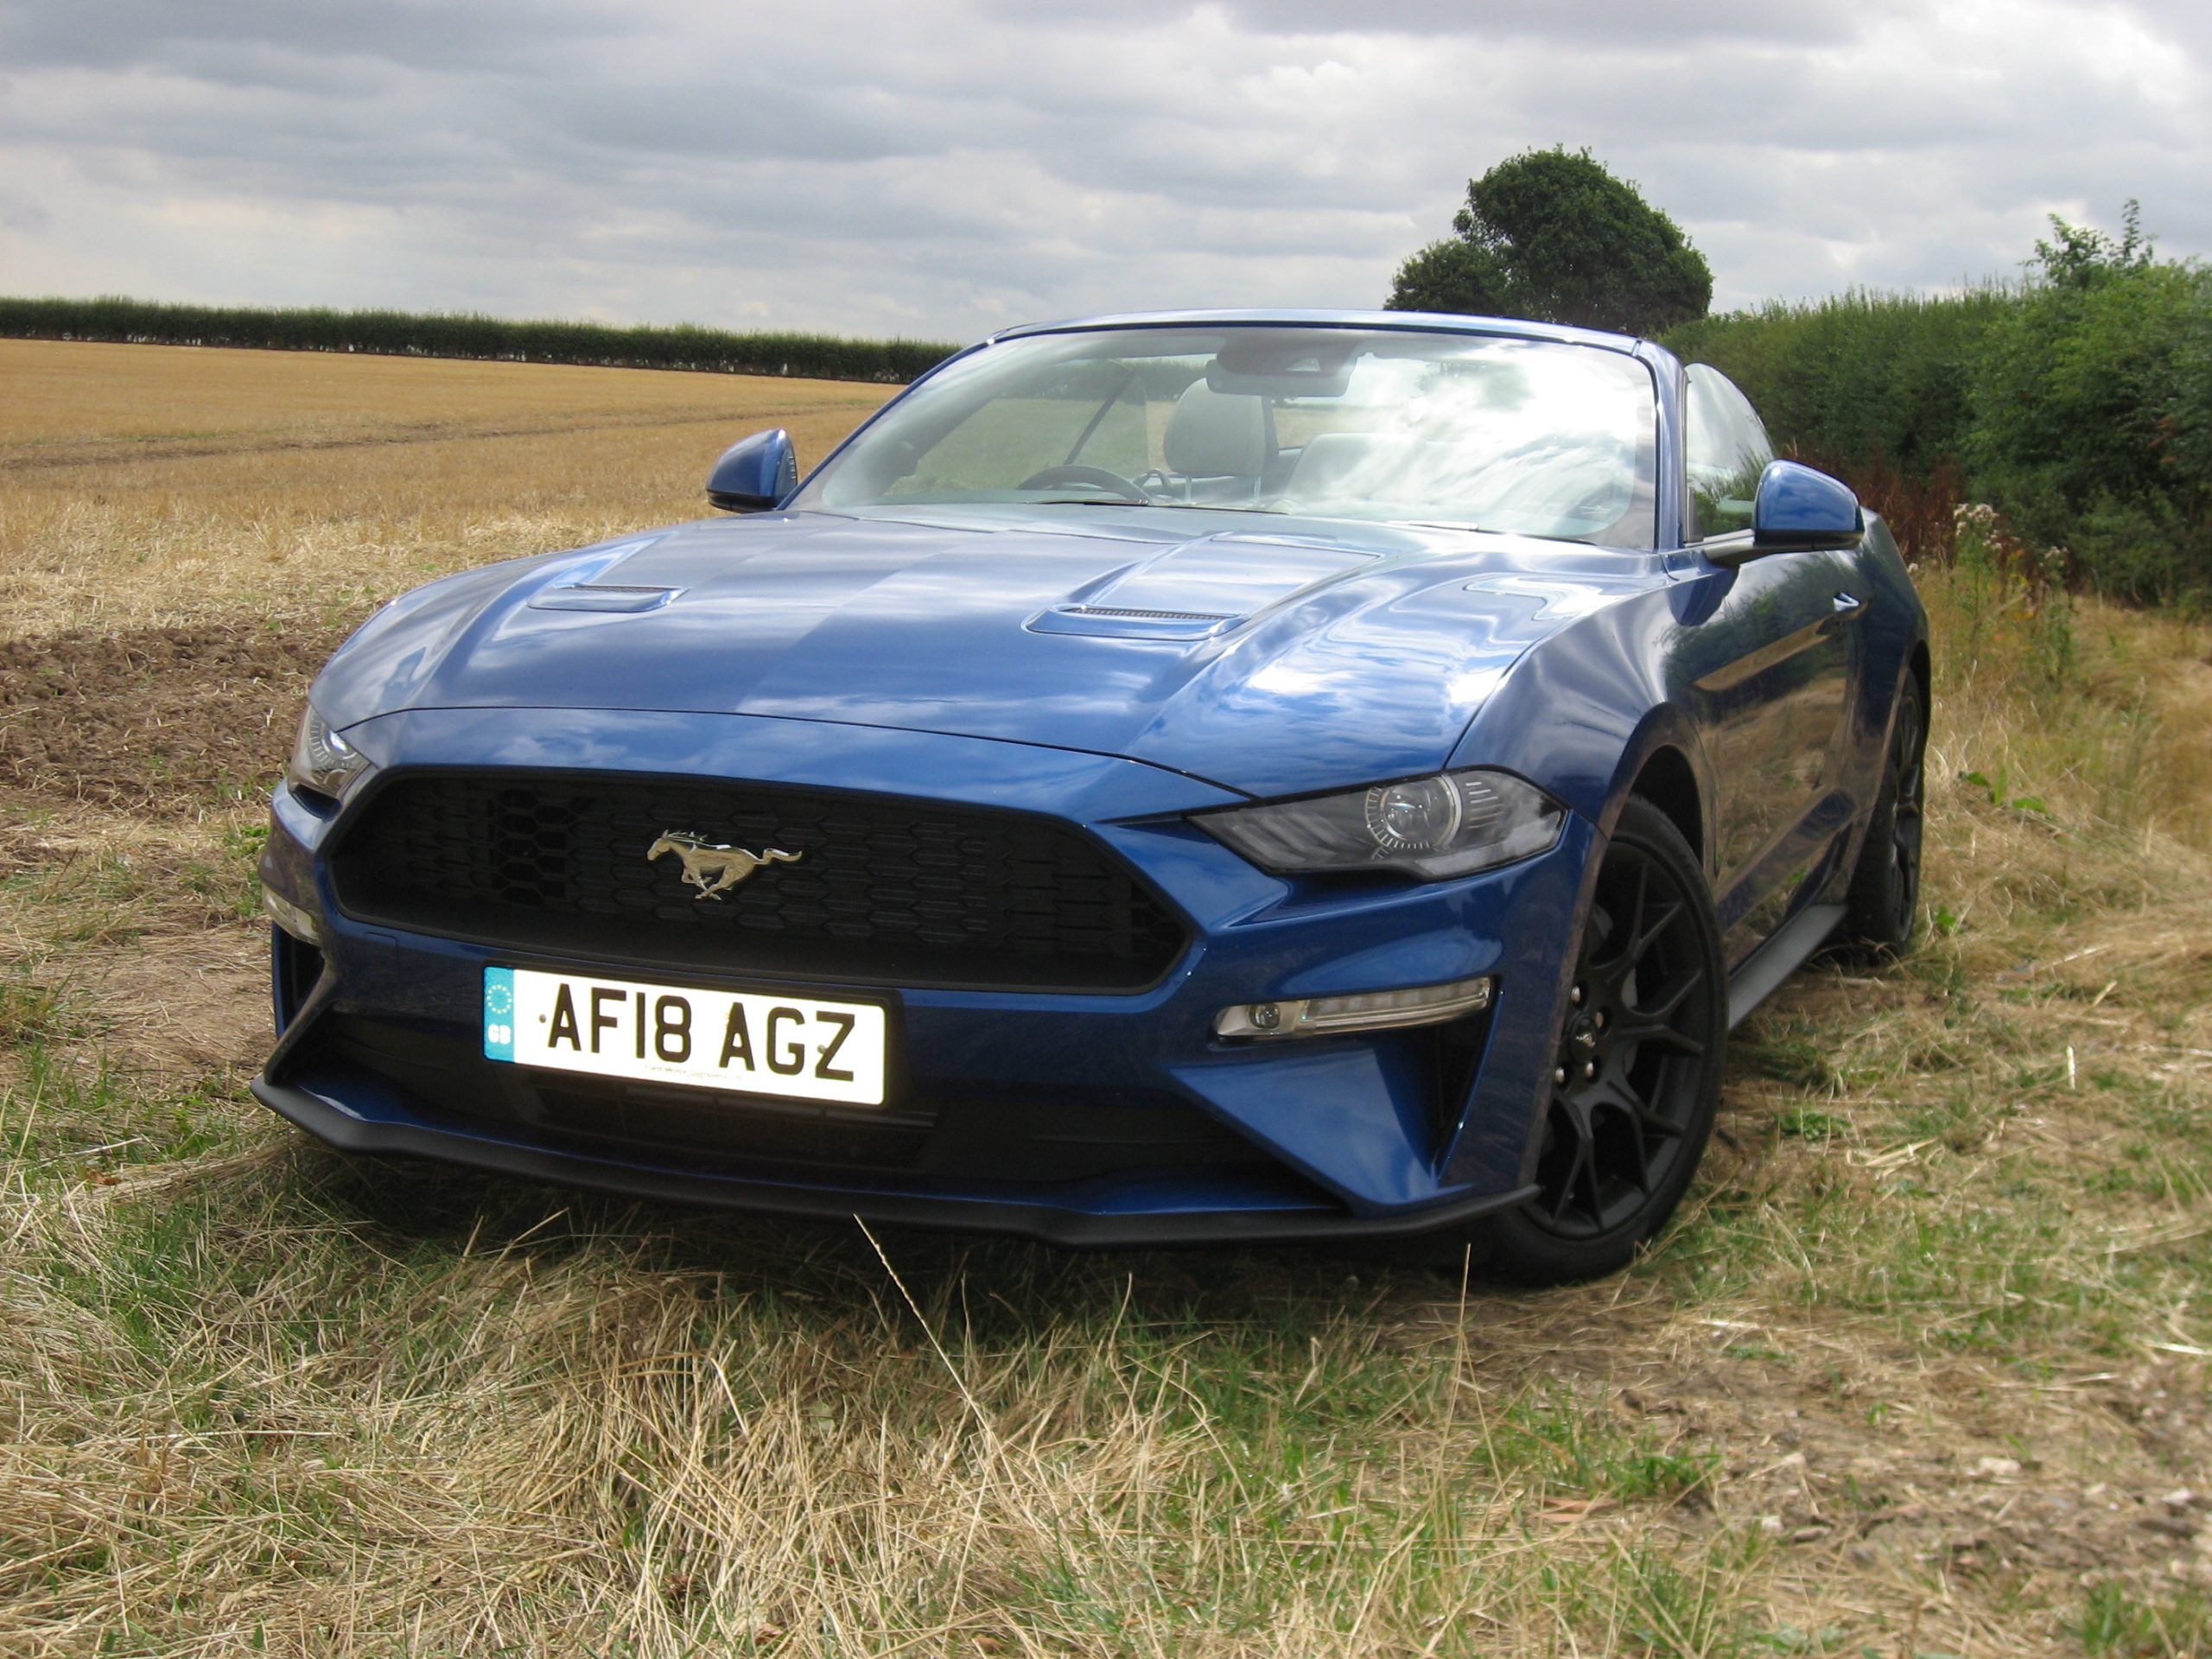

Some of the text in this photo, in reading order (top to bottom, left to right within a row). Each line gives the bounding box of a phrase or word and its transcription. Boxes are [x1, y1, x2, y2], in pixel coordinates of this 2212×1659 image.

[487, 1023, 512, 1045] GB
[548, 983, 856, 1082] AF18 AGZ
